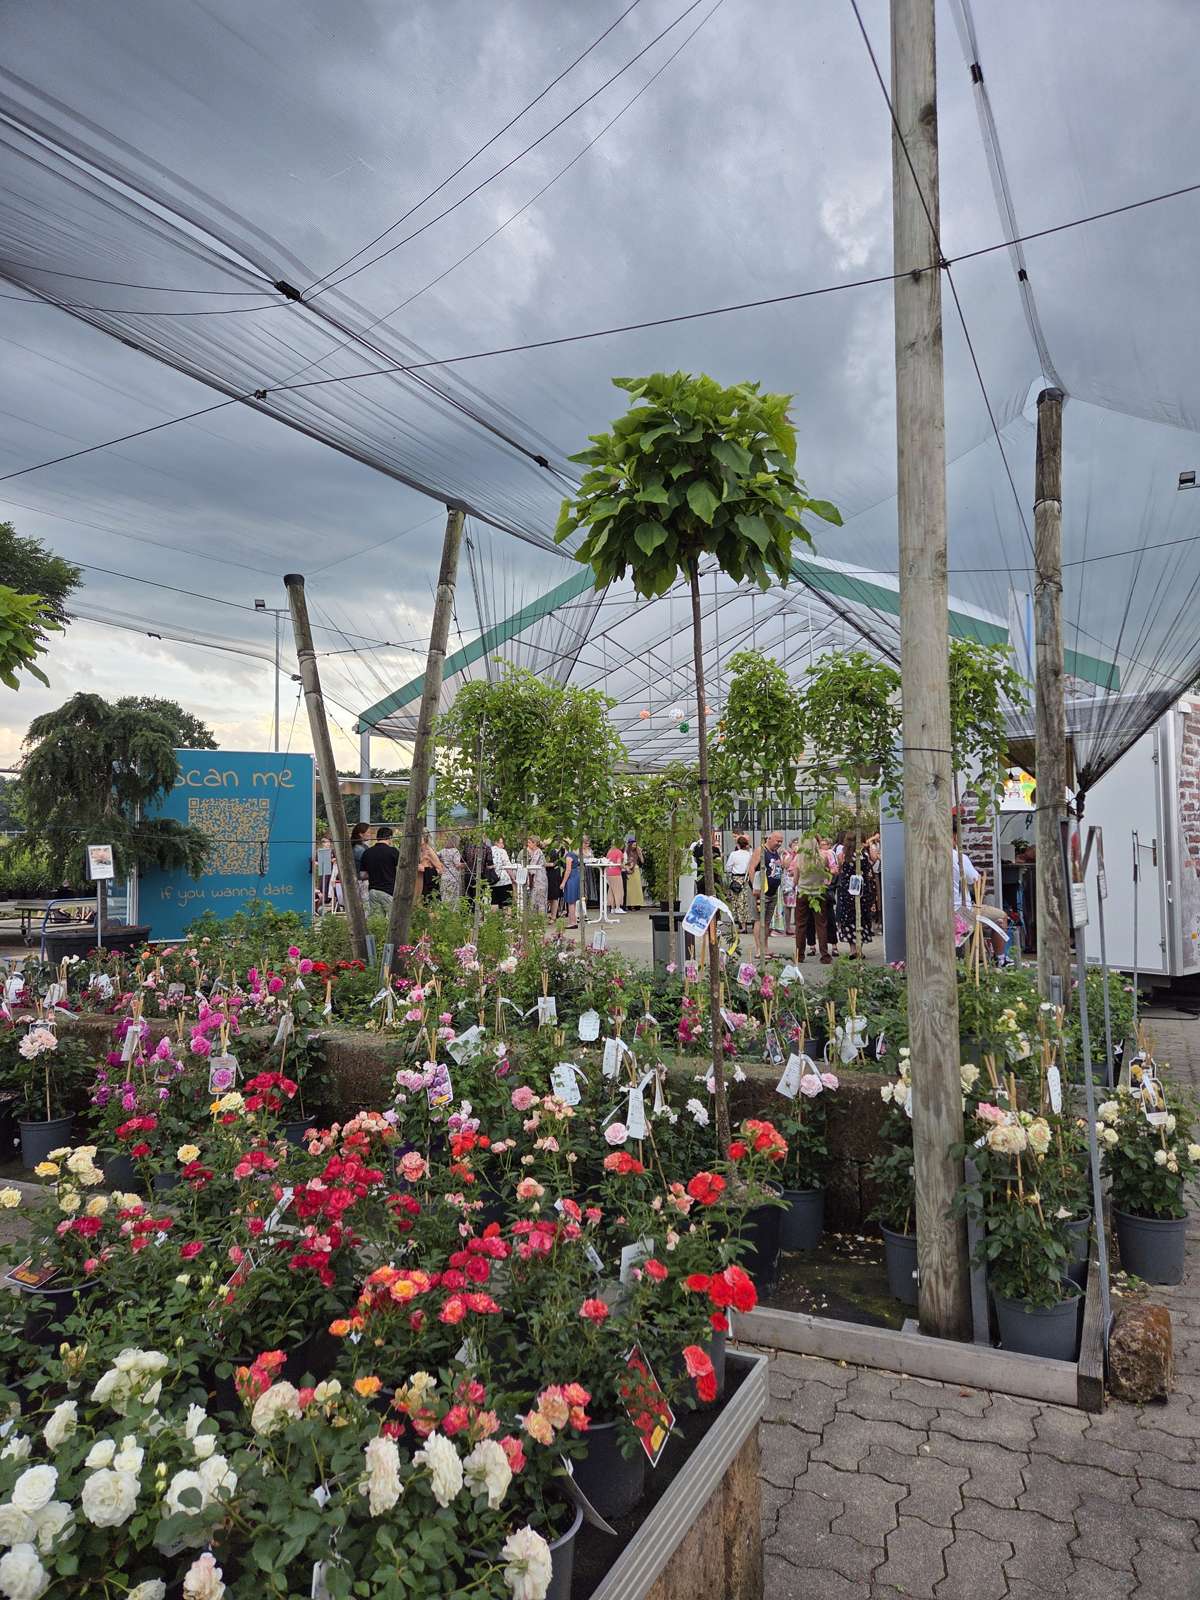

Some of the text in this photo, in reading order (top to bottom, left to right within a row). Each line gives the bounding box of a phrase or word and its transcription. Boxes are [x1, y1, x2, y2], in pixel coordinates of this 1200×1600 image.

[251, 769, 296, 788] me
[177, 887, 205, 907] you
[211, 887, 257, 898] wanna
[263, 882, 294, 896] date
